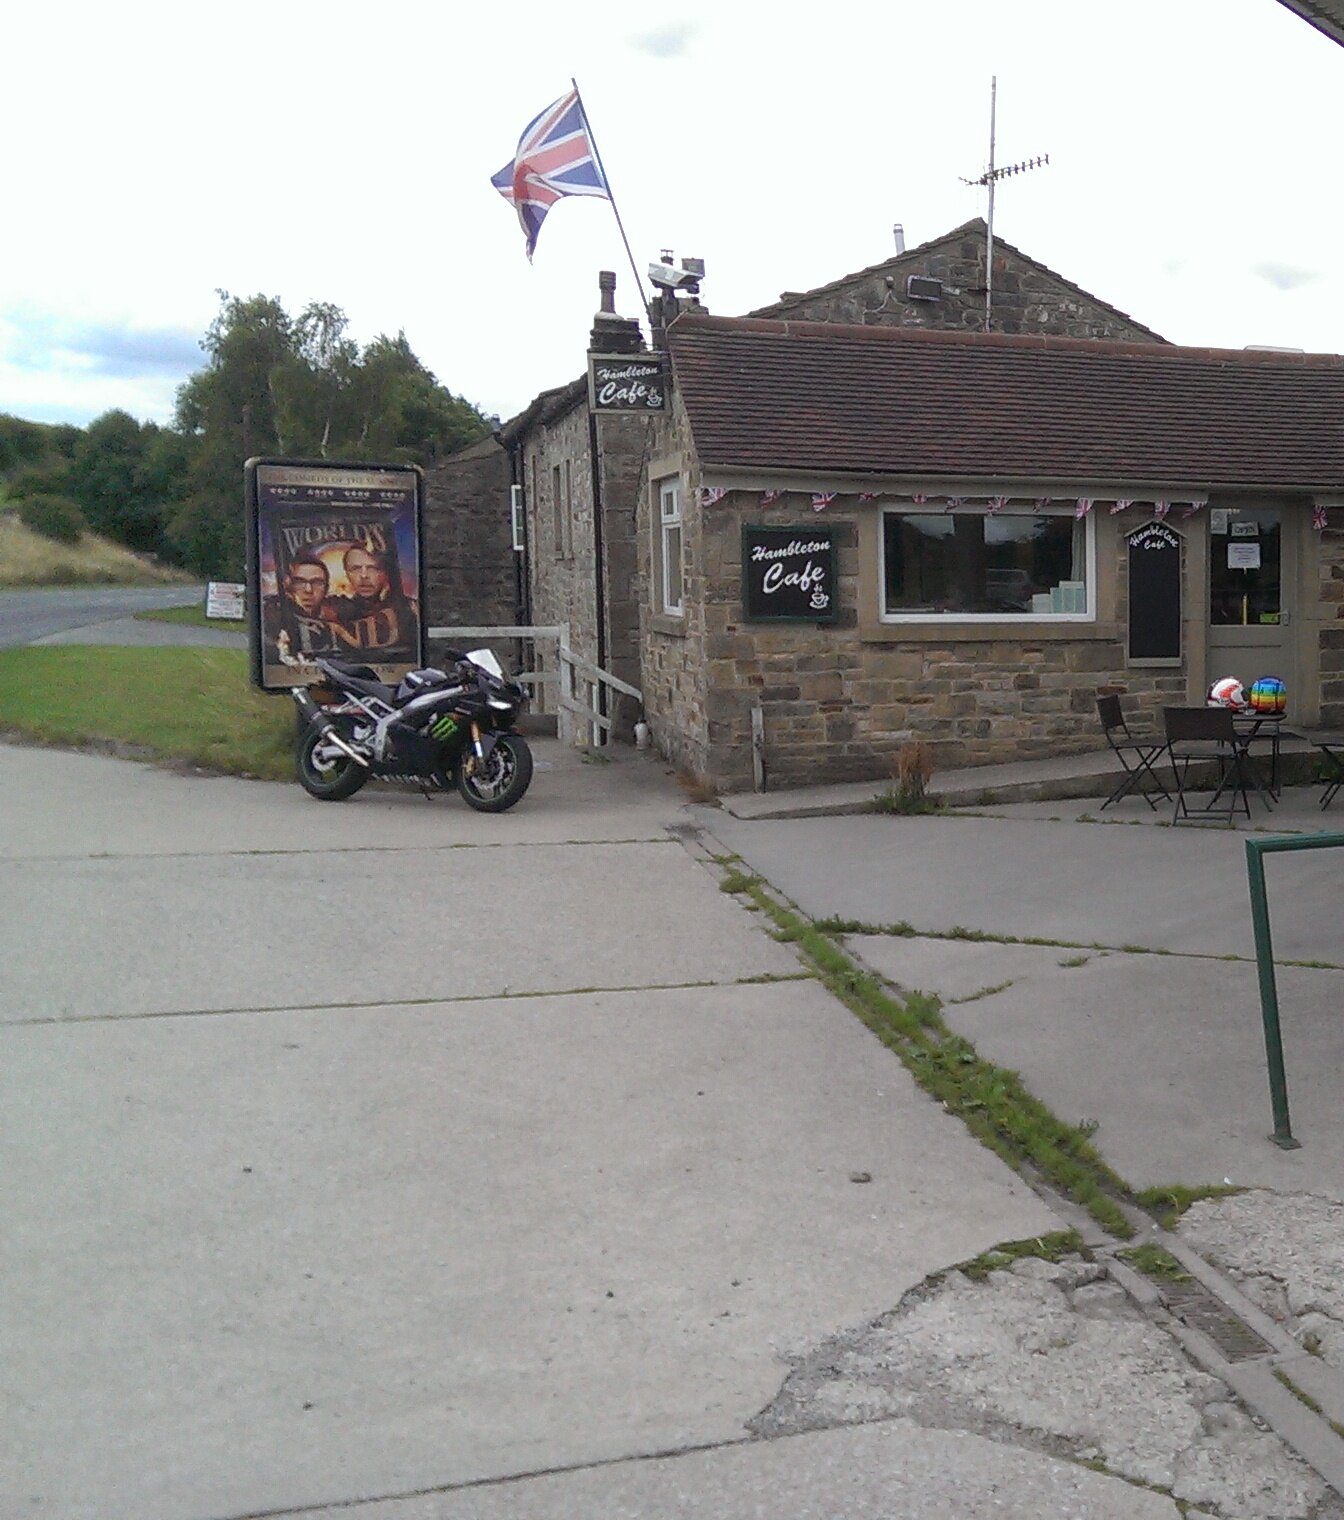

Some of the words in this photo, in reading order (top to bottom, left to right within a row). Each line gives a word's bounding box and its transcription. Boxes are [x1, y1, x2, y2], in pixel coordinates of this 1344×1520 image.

[597, 366, 658, 380] Hambleton
[599, 381, 647, 404] Cafe
[751, 540, 831, 561] Hambleton
[762, 560, 825, 594] Cafe
[295, 607, 399, 651] END
